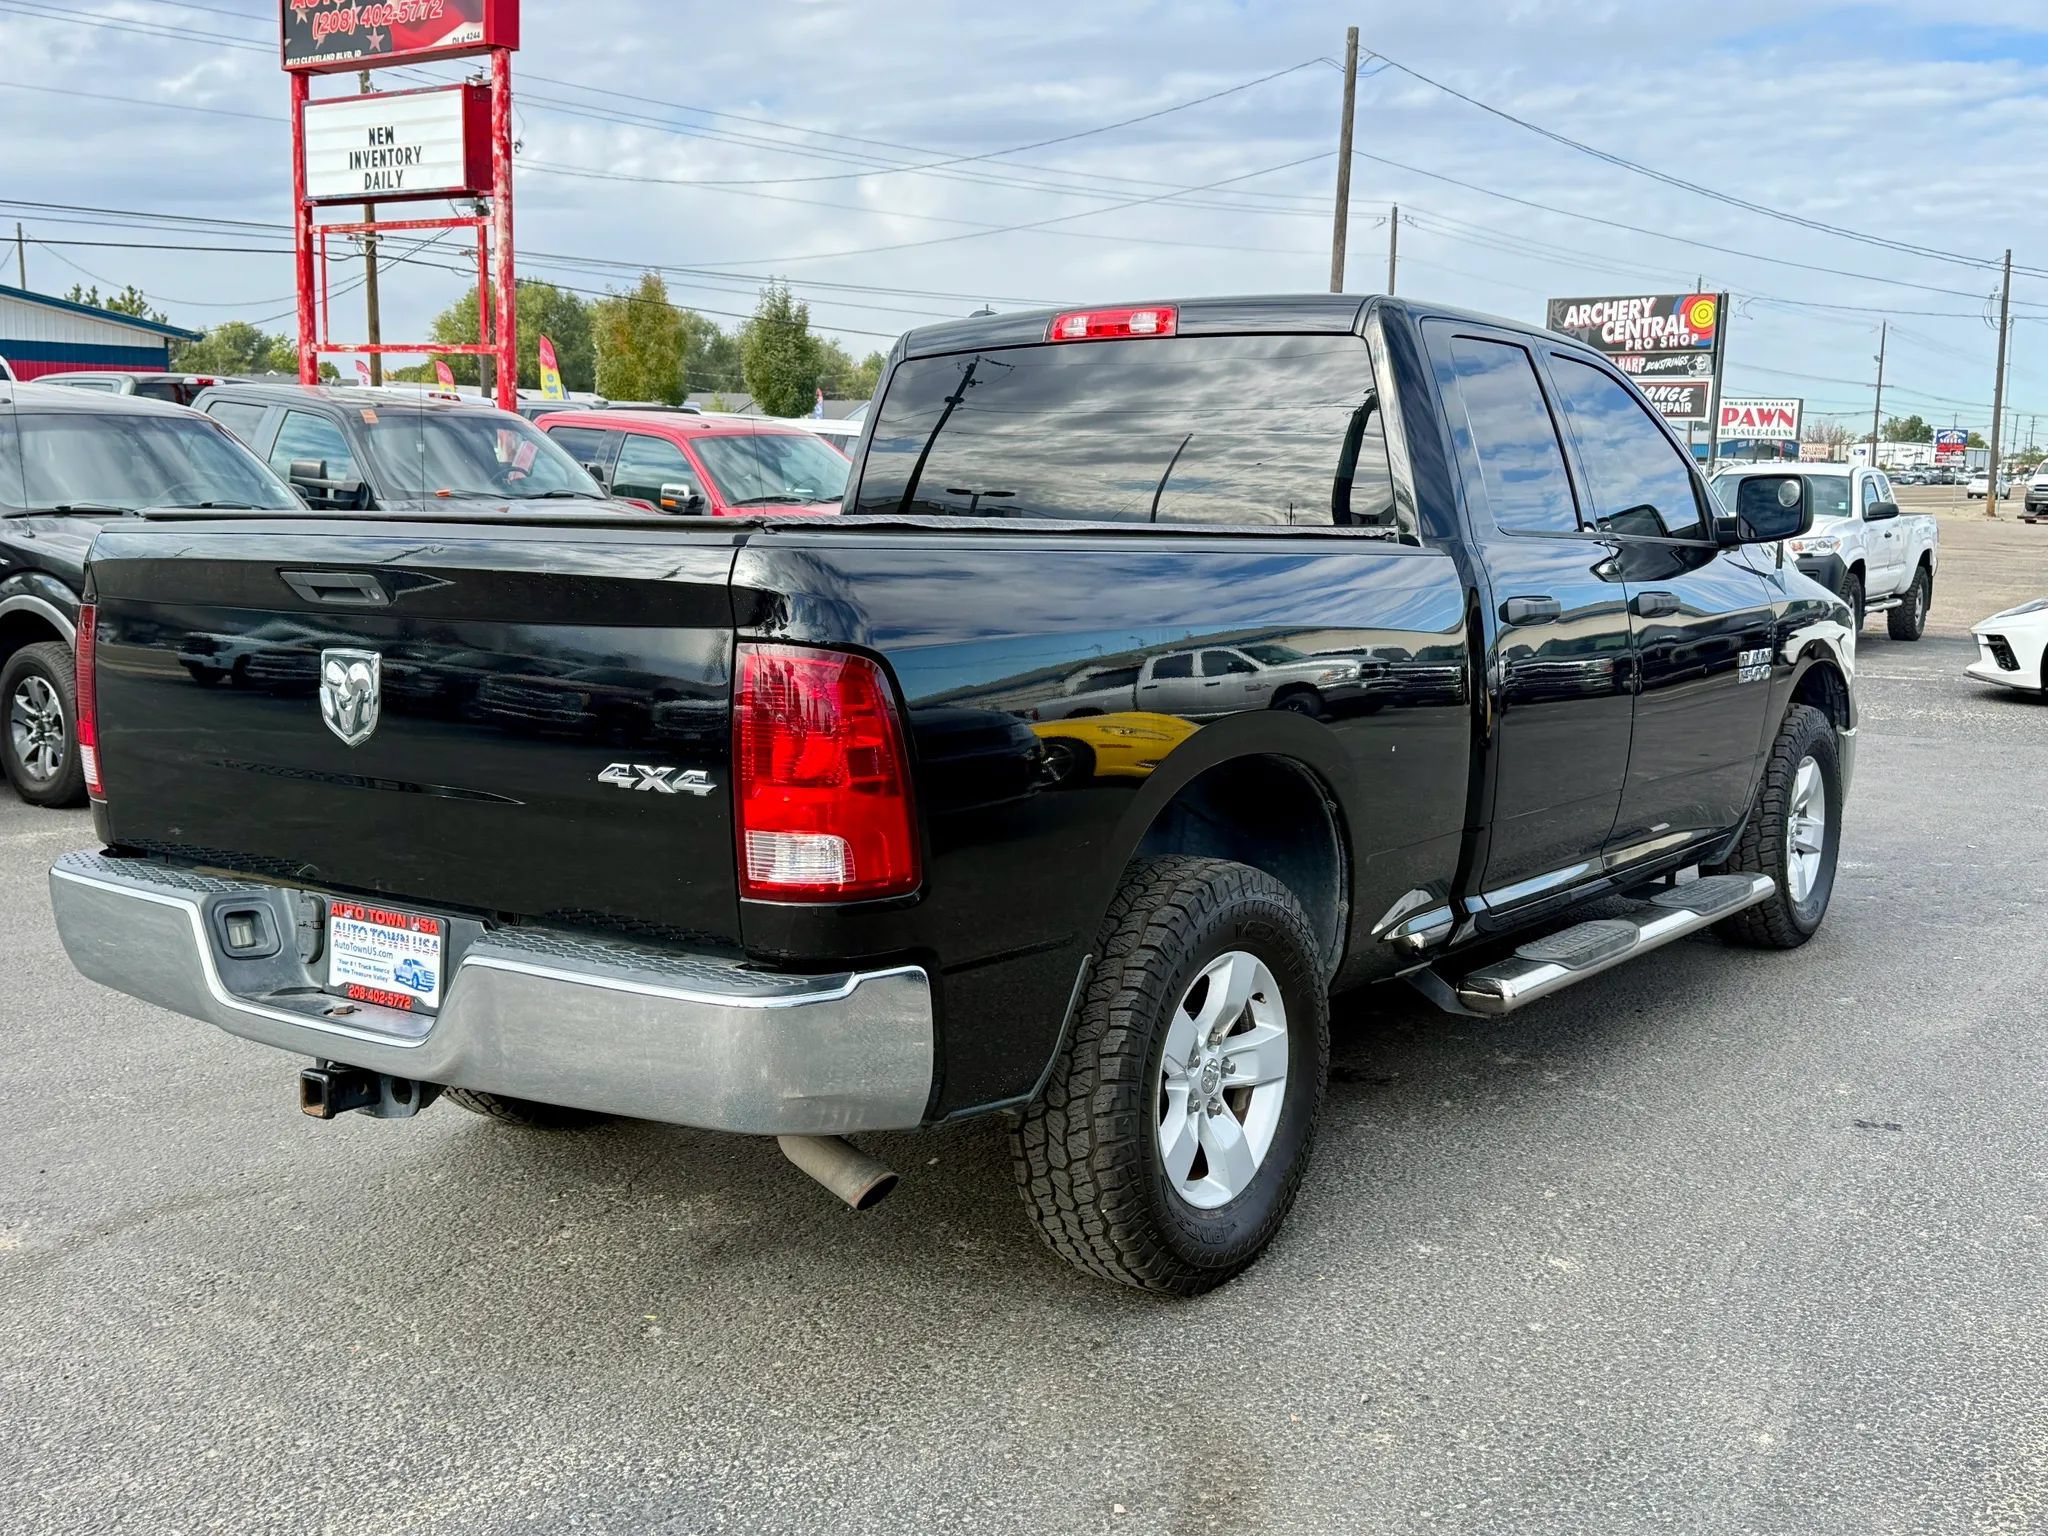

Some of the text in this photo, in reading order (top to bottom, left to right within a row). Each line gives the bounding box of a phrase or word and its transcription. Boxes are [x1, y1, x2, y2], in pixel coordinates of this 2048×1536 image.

[312, 9, 356, 40] (208)
[301, 53, 335, 64] CLEVELAND
[368, 126, 394, 146] NEW
[349, 146, 422, 170] INVENTORY
[364, 169, 404, 190] DAILY
[1563, 297, 1657, 328] ARCHERY
[1601, 314, 1690, 344] CENTRAL
[1625, 334, 1699, 351] PRO SHOP
[1644, 355, 1690, 371] BOWSTRINGS
[1721, 407, 1796, 428] PAWN
[1739, 647, 1773, 667] RAM
[1739, 664, 1773, 684] 1500
[330, 902, 439, 934] AUTO TOWN USA
[334, 939, 394, 959] AutoTownUS.com
